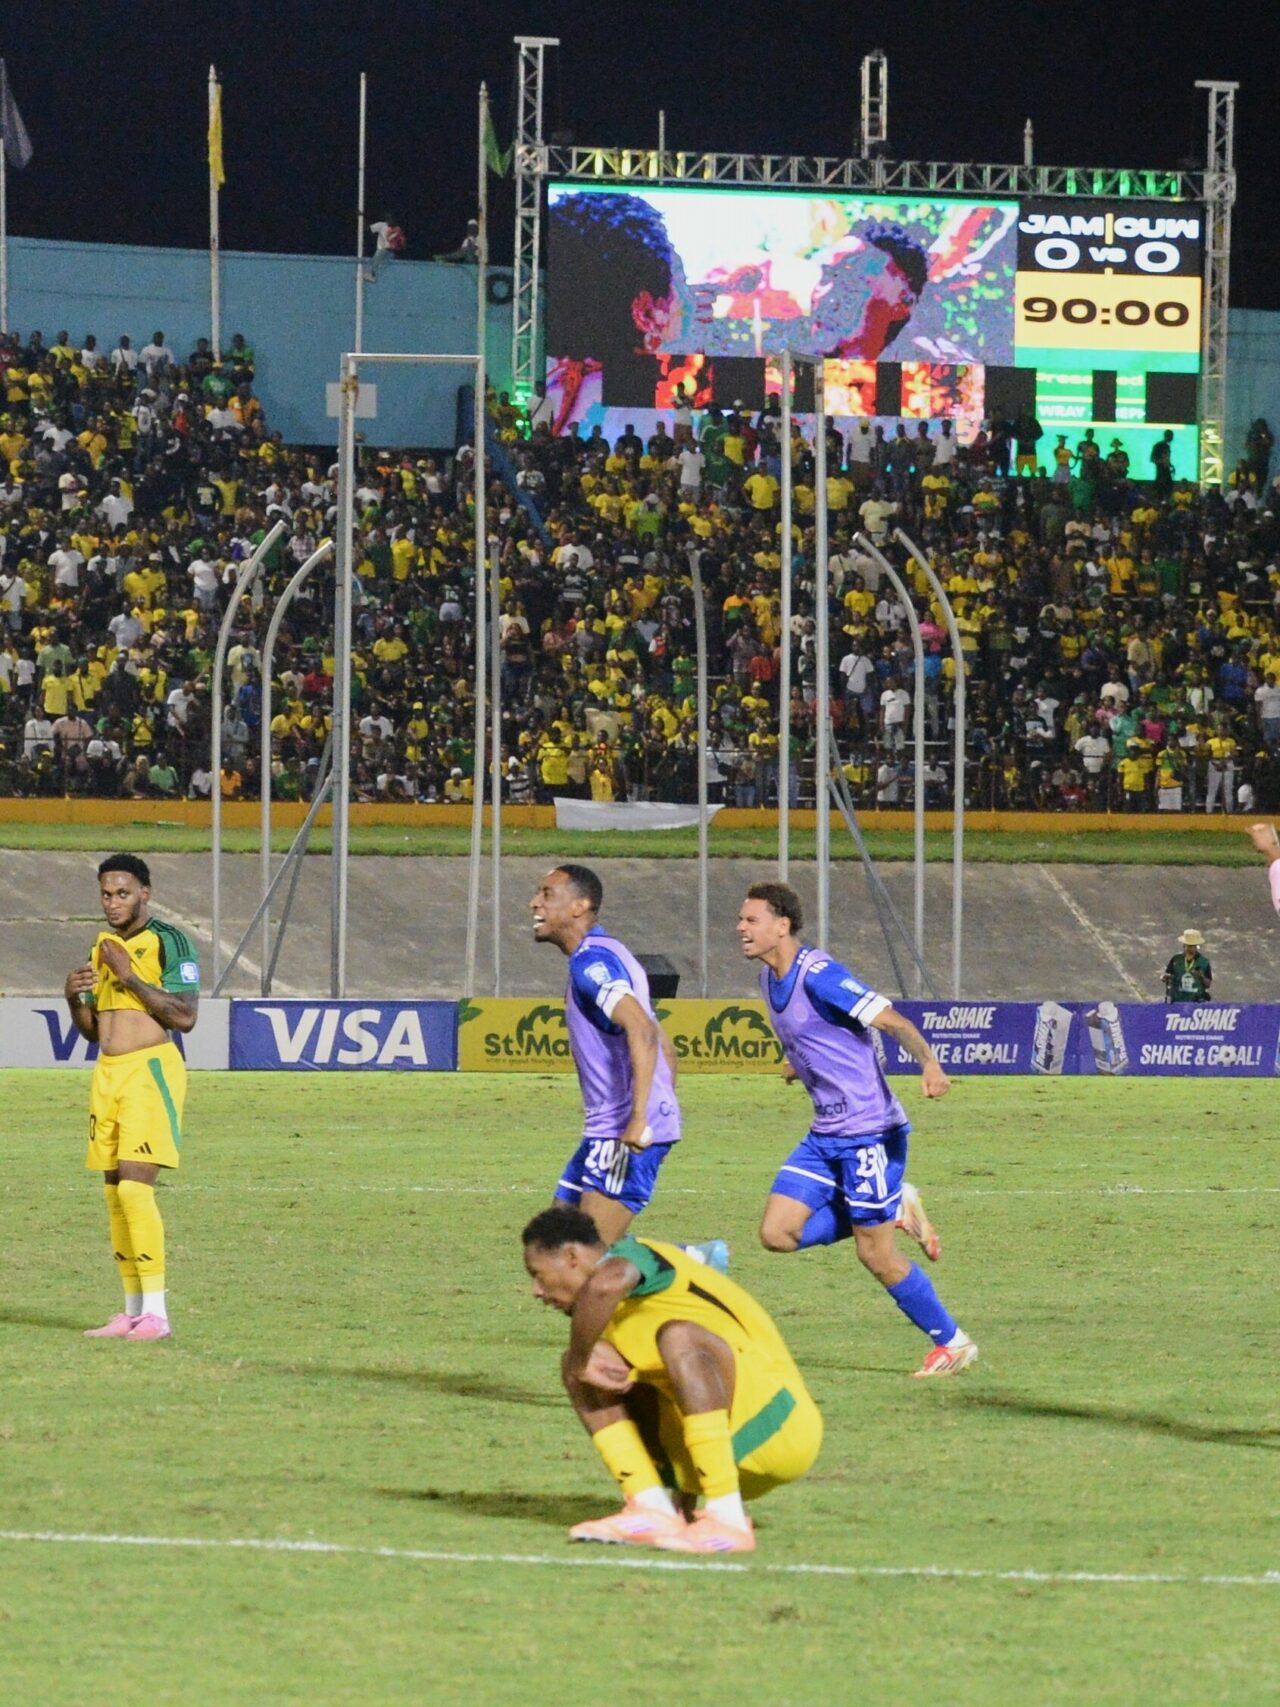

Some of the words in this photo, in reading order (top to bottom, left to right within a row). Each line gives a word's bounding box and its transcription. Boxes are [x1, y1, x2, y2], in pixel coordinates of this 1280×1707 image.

[1019, 215, 1105, 236] JAM
[1034, 238, 1081, 270] 0
[1134, 242, 1180, 273] 0
[1023, 297, 1190, 328] 90:00
[922, 1007, 997, 1030] TruSHAKE
[1165, 1009, 1240, 1031] TruSHAKE
[254, 1007, 429, 1065] VISA
[951, 1046, 962, 1064] &
[1140, 1045, 1193, 1066] SHAKE
[1195, 1048, 1205, 1066] &
[585, 1140, 615, 1170] 20
[856, 1146, 879, 1178] 13
